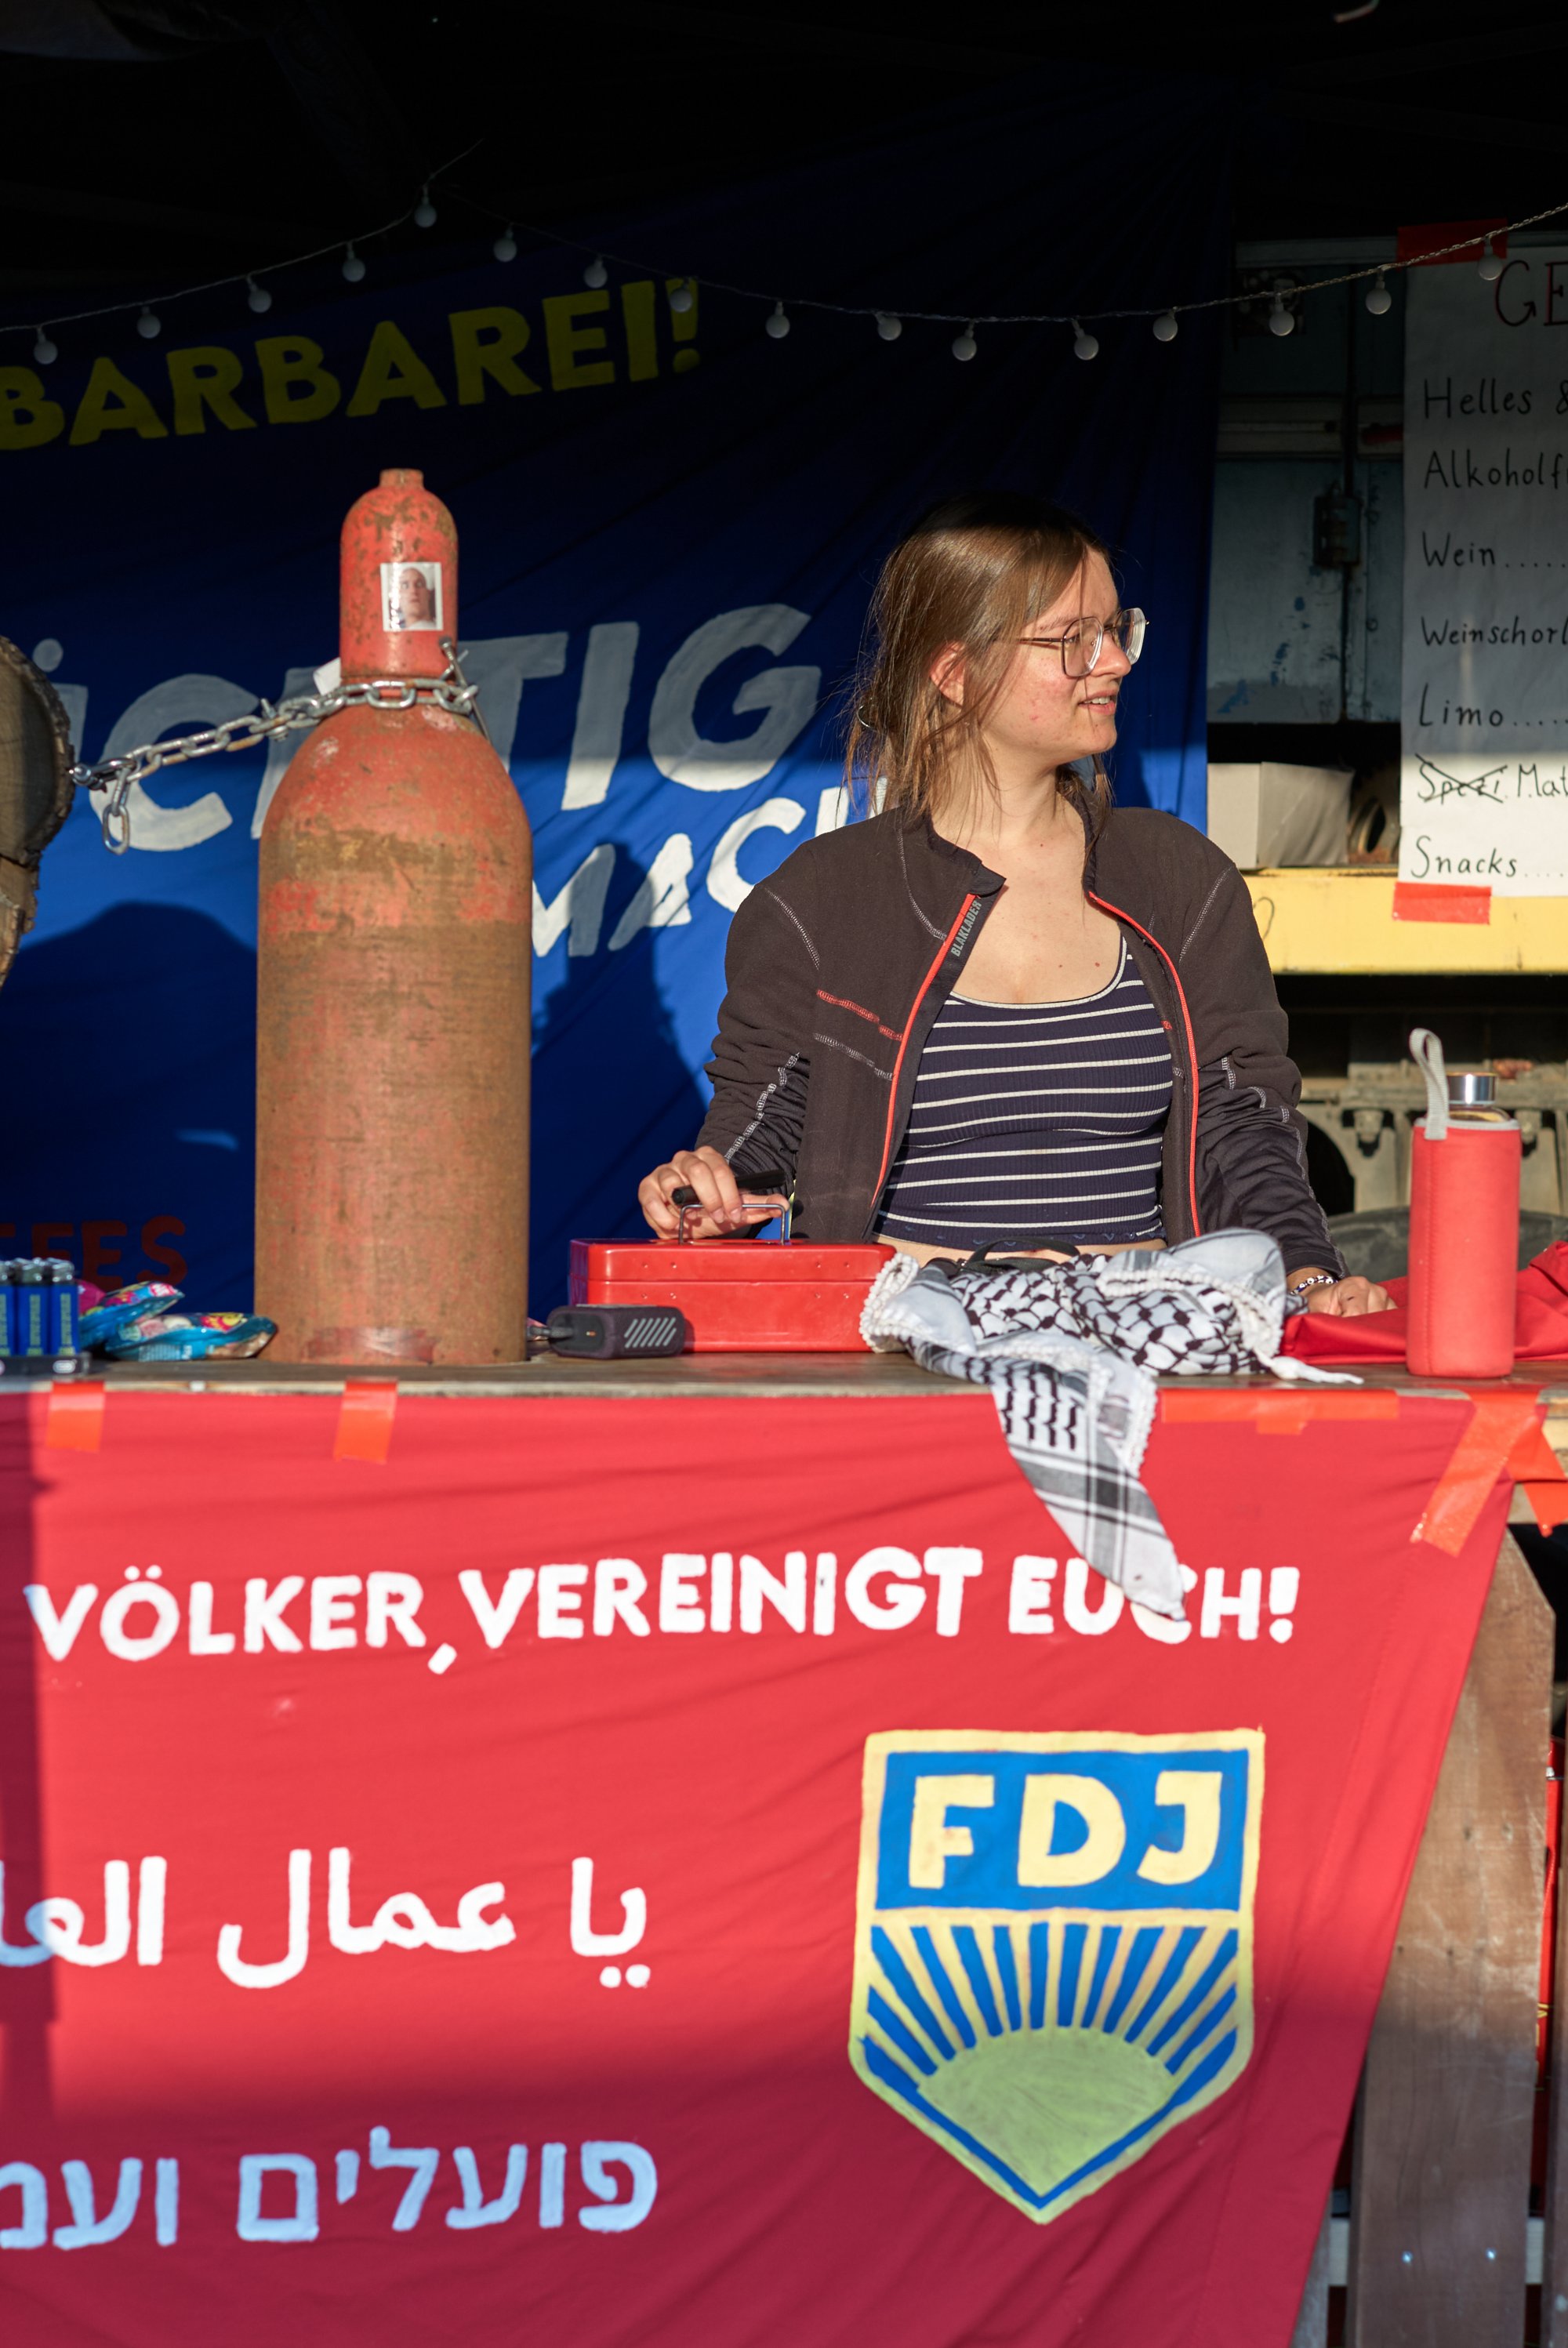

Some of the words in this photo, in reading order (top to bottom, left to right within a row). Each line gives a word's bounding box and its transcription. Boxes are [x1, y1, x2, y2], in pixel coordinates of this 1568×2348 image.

[0, 278, 701, 451] BARBAREI!
[1424, 378, 1532, 419] Helles
[1425, 448, 1568, 490] Alkoholf
[24, 1565, 457, 1675] VÖLKER,
[459, 1547, 983, 1649] VEREINIGT
[909, 1771, 1222, 1889] FDJ
[217, 1847, 517, 1989] عمال
[571, 1856, 651, 1988] يا
[237, 2125, 658, 2243] פועלים
